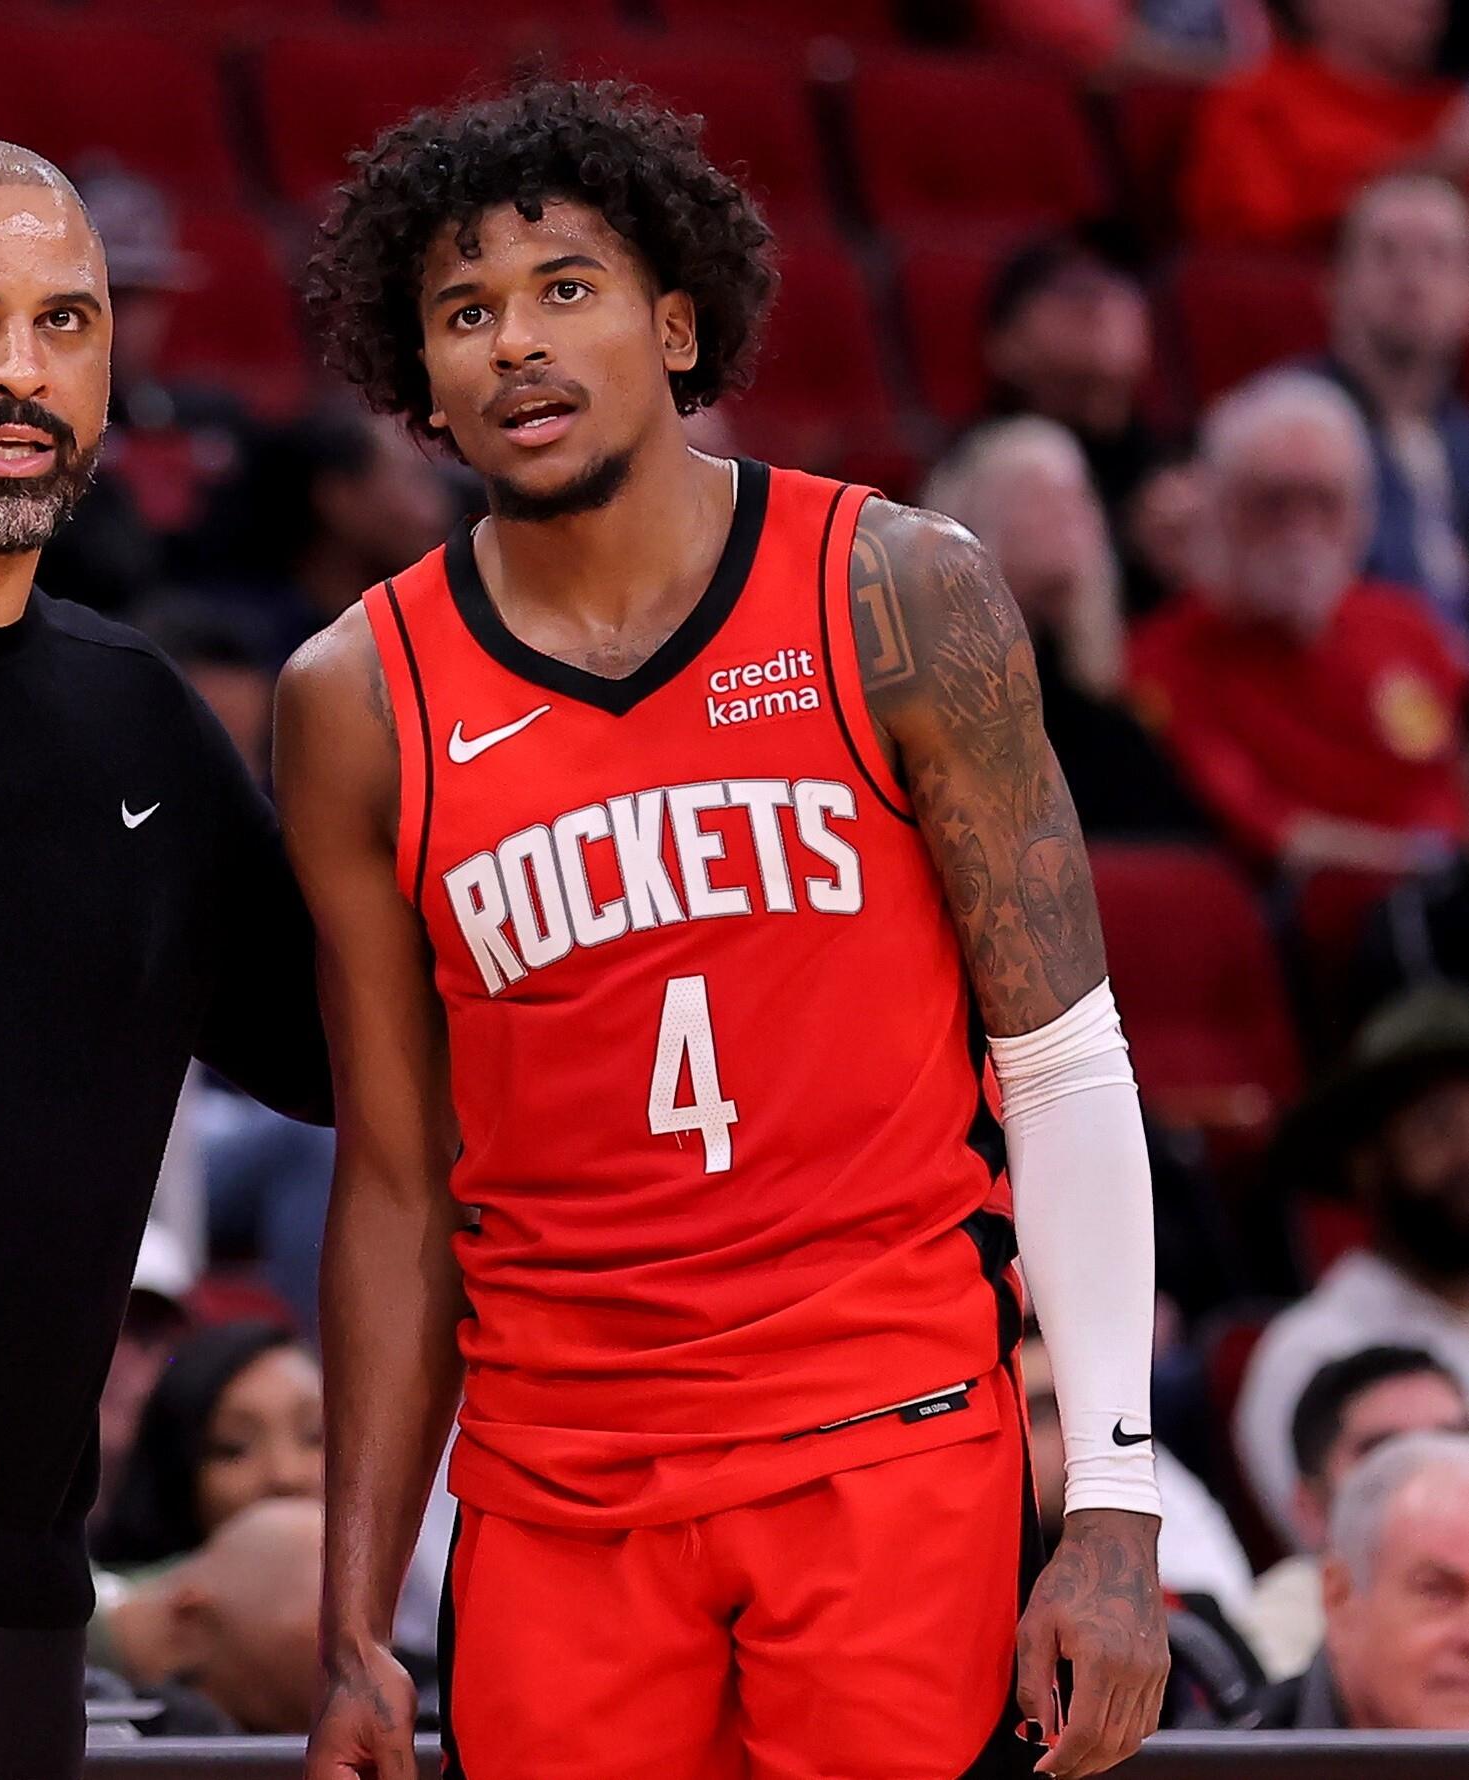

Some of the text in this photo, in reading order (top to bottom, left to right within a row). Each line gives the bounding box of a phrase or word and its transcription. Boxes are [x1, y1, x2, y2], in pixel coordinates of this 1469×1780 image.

[706, 686, 820, 728] karma
[709, 648, 815, 693] credit
[443, 778, 863, 997] ROCKETS
[648, 975, 738, 1173] 4
